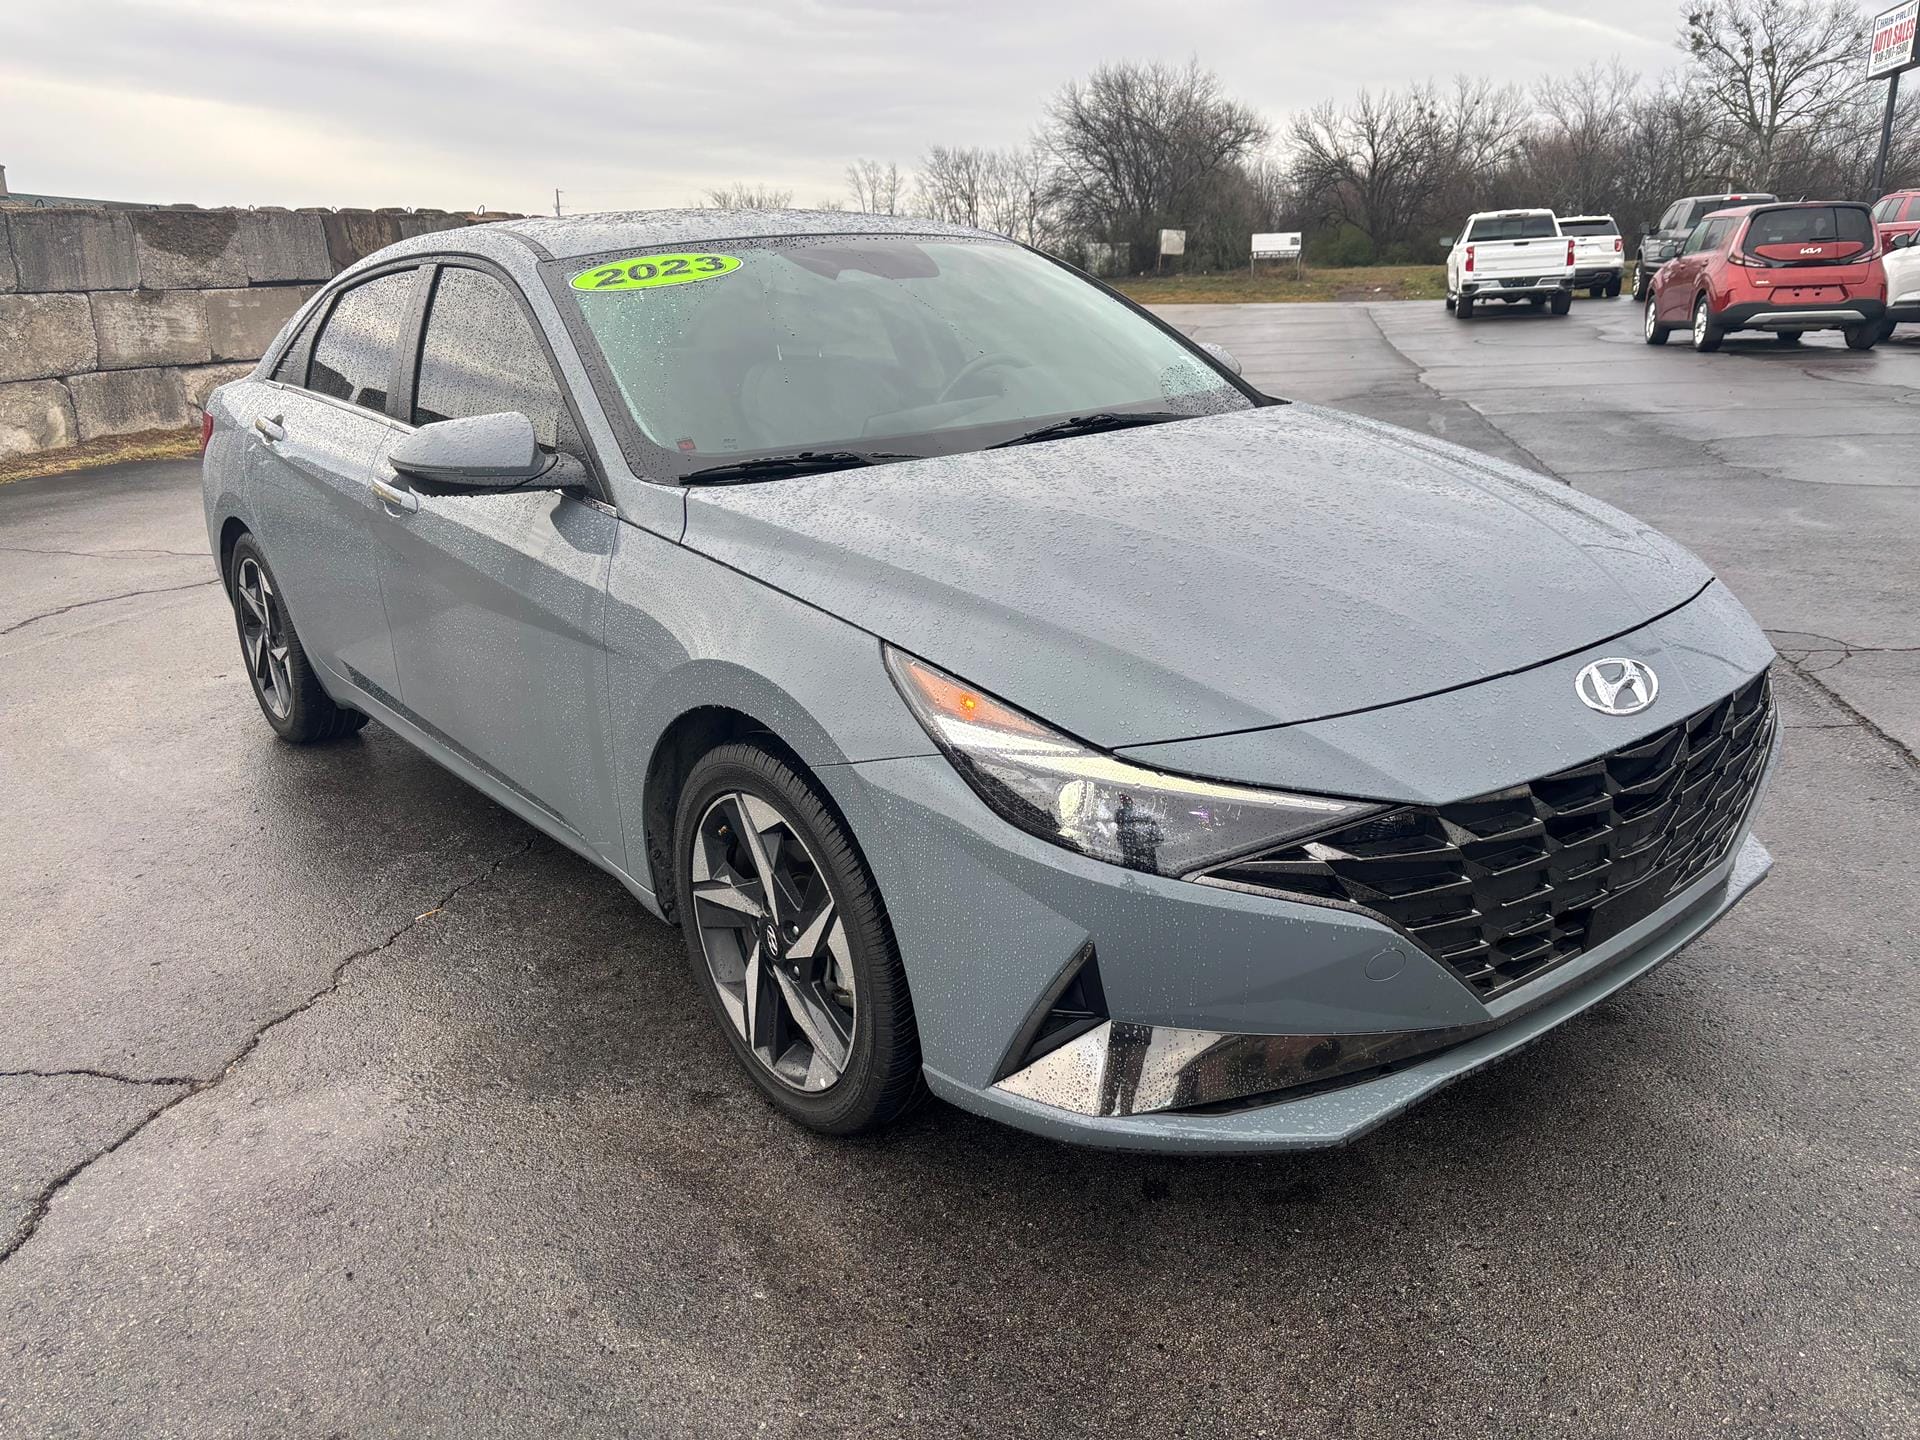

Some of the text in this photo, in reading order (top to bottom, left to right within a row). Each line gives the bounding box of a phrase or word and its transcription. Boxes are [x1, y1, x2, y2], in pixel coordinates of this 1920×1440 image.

[1873, 18, 1915, 53] AUTO SALES
[593, 256, 727, 288] 2023
